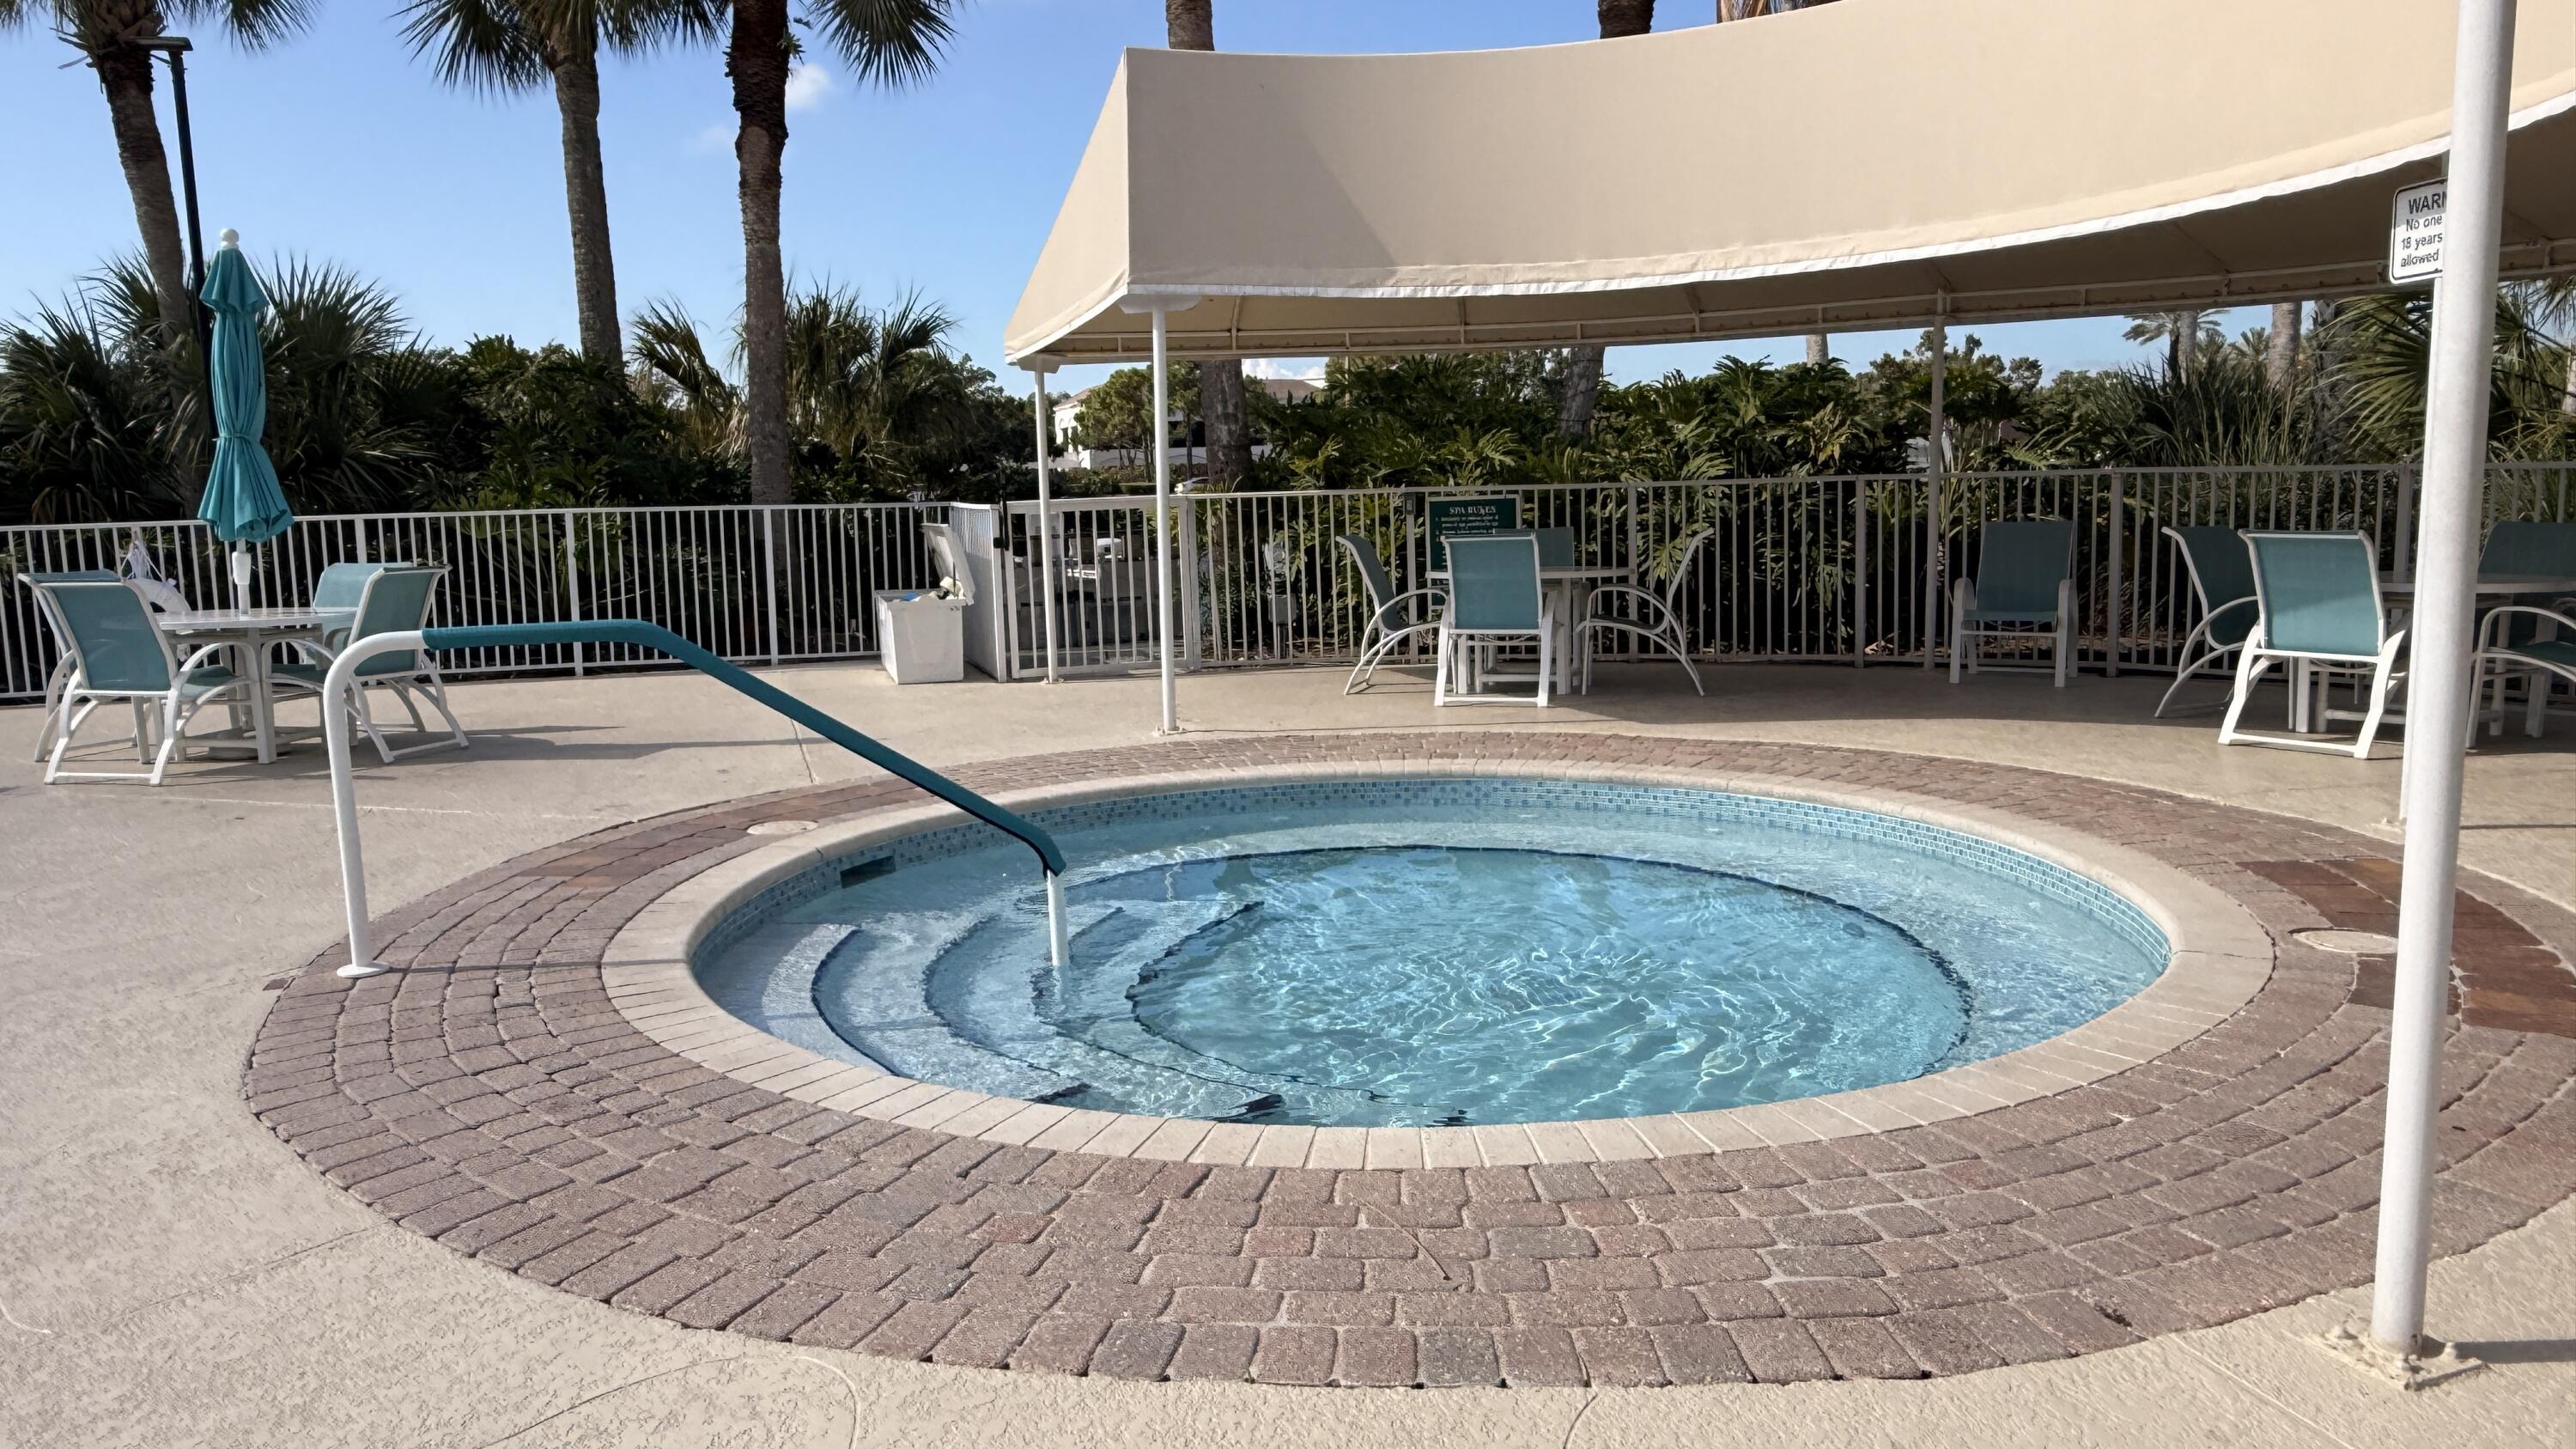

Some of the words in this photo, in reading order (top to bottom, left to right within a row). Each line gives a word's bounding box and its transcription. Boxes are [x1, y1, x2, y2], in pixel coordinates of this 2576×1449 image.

[2406, 219, 2420, 232] No
[2423, 215, 2443, 228] one
[2402, 236, 2412, 251] 18
[2415, 233, 2443, 251] years
[2401, 248, 2439, 267] allowed
